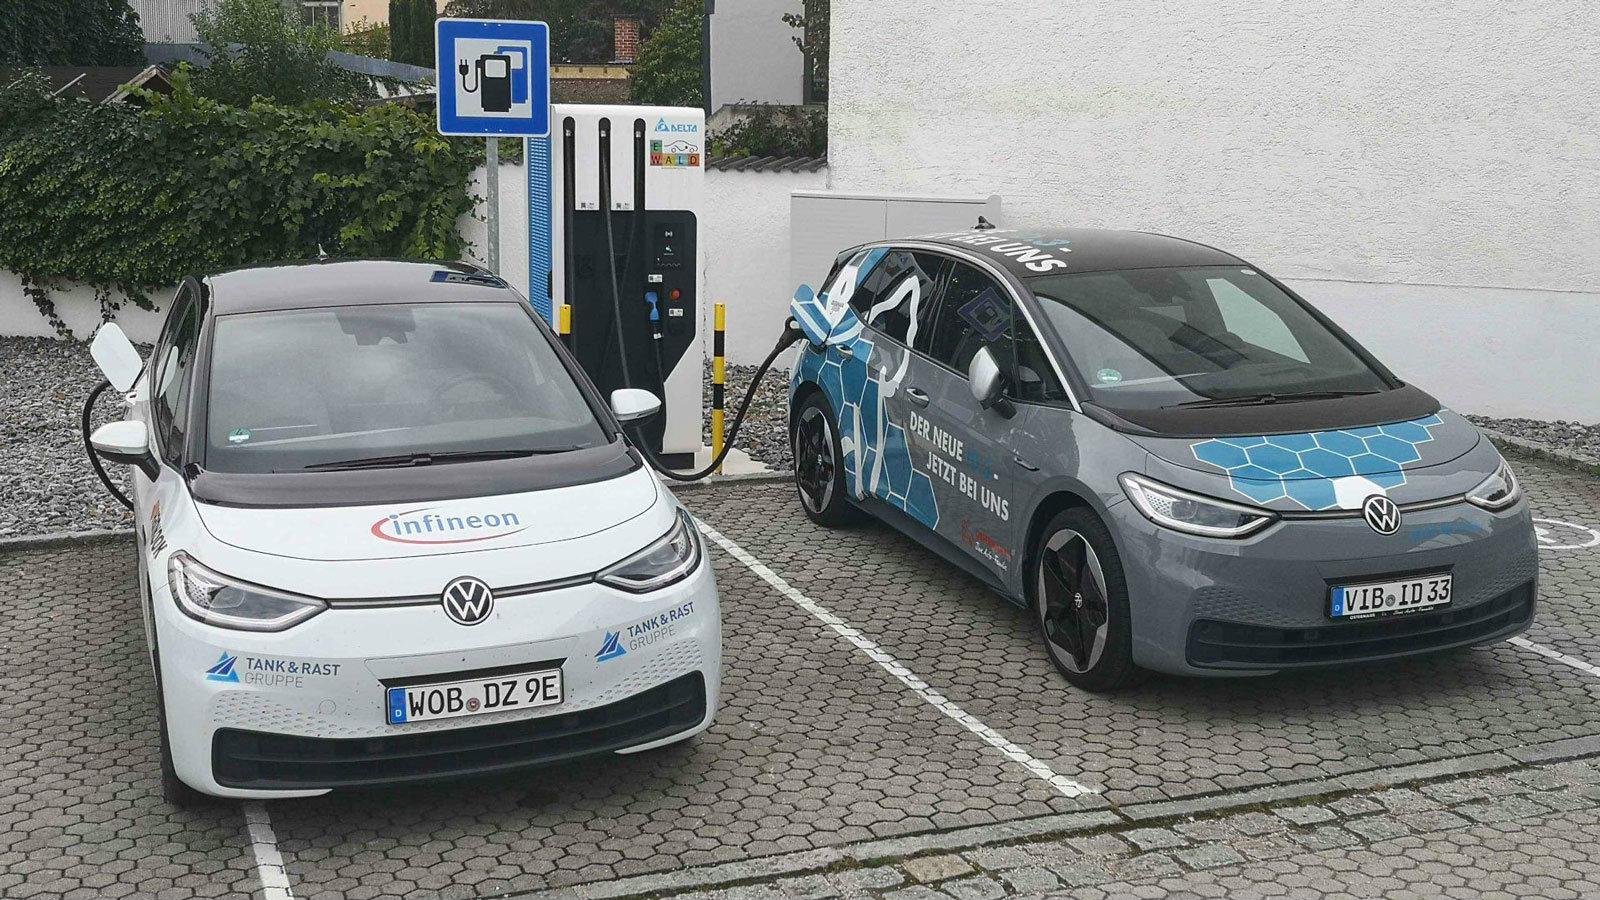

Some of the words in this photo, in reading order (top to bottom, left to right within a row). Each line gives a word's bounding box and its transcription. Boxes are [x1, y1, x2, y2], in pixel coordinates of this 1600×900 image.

[671, 124, 698, 133] DELTA
[651, 155, 698, 166] WALD
[990, 242, 1068, 272] UNS
[909, 410, 930, 441] DER
[933, 425, 964, 462] NEUE
[926, 451, 957, 486] JETZT
[959, 472, 977, 501] BEI
[981, 486, 1009, 521] UNS
[389, 512, 520, 536] infineon
[1345, 587, 1384, 612] VIB
[1399, 582, 1423, 606] ID
[1427, 578, 1451, 602] 33
[627, 616, 660, 638] TANK
[660, 613, 669, 625] &
[669, 601, 695, 622] RAST
[629, 625, 677, 651] GRUPPE
[244, 672, 304, 688] GRUPPE
[246, 657, 285, 674] TANK
[288, 661, 299, 674] &
[301, 662, 341, 676] RAST
[408, 687, 464, 717] WOB
[484, 680, 519, 708] DZ
[525, 675, 559, 703] 9E
